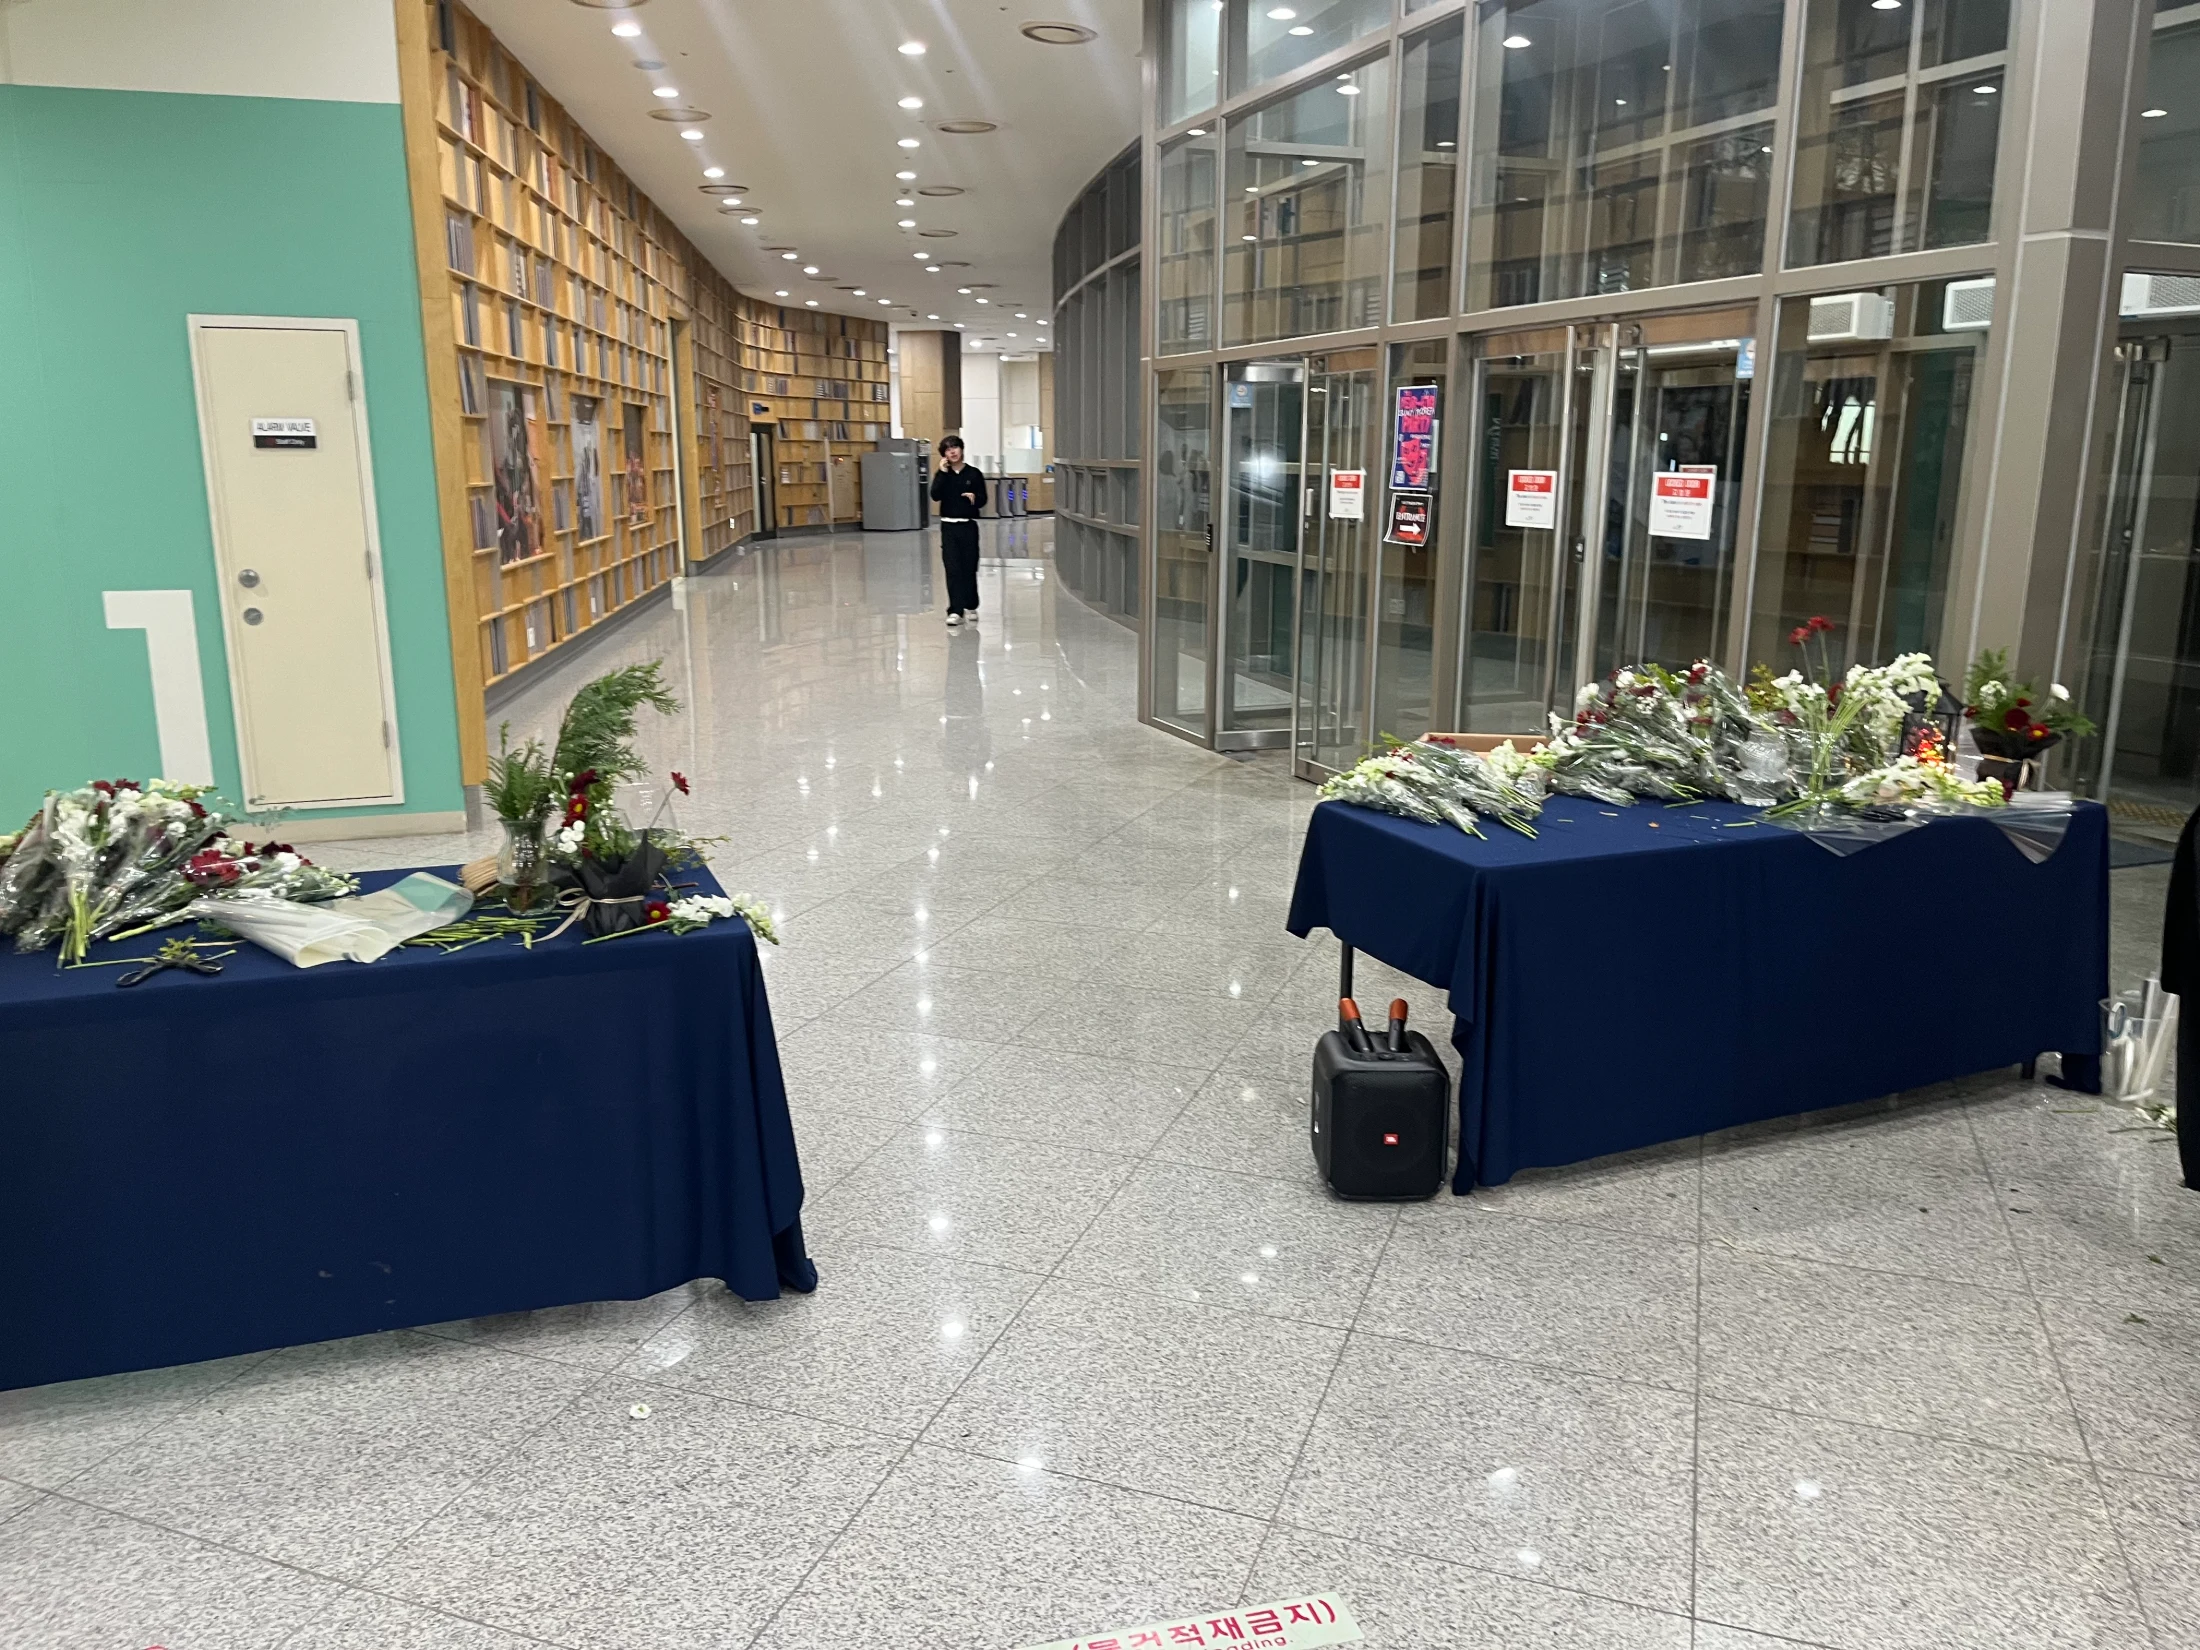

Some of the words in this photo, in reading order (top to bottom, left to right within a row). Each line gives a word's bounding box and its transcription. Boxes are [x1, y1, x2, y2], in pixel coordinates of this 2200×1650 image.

[257, 423, 284, 432] ALARM
[287, 423, 311, 432] VALVE
[102, 590, 214, 787] 1
